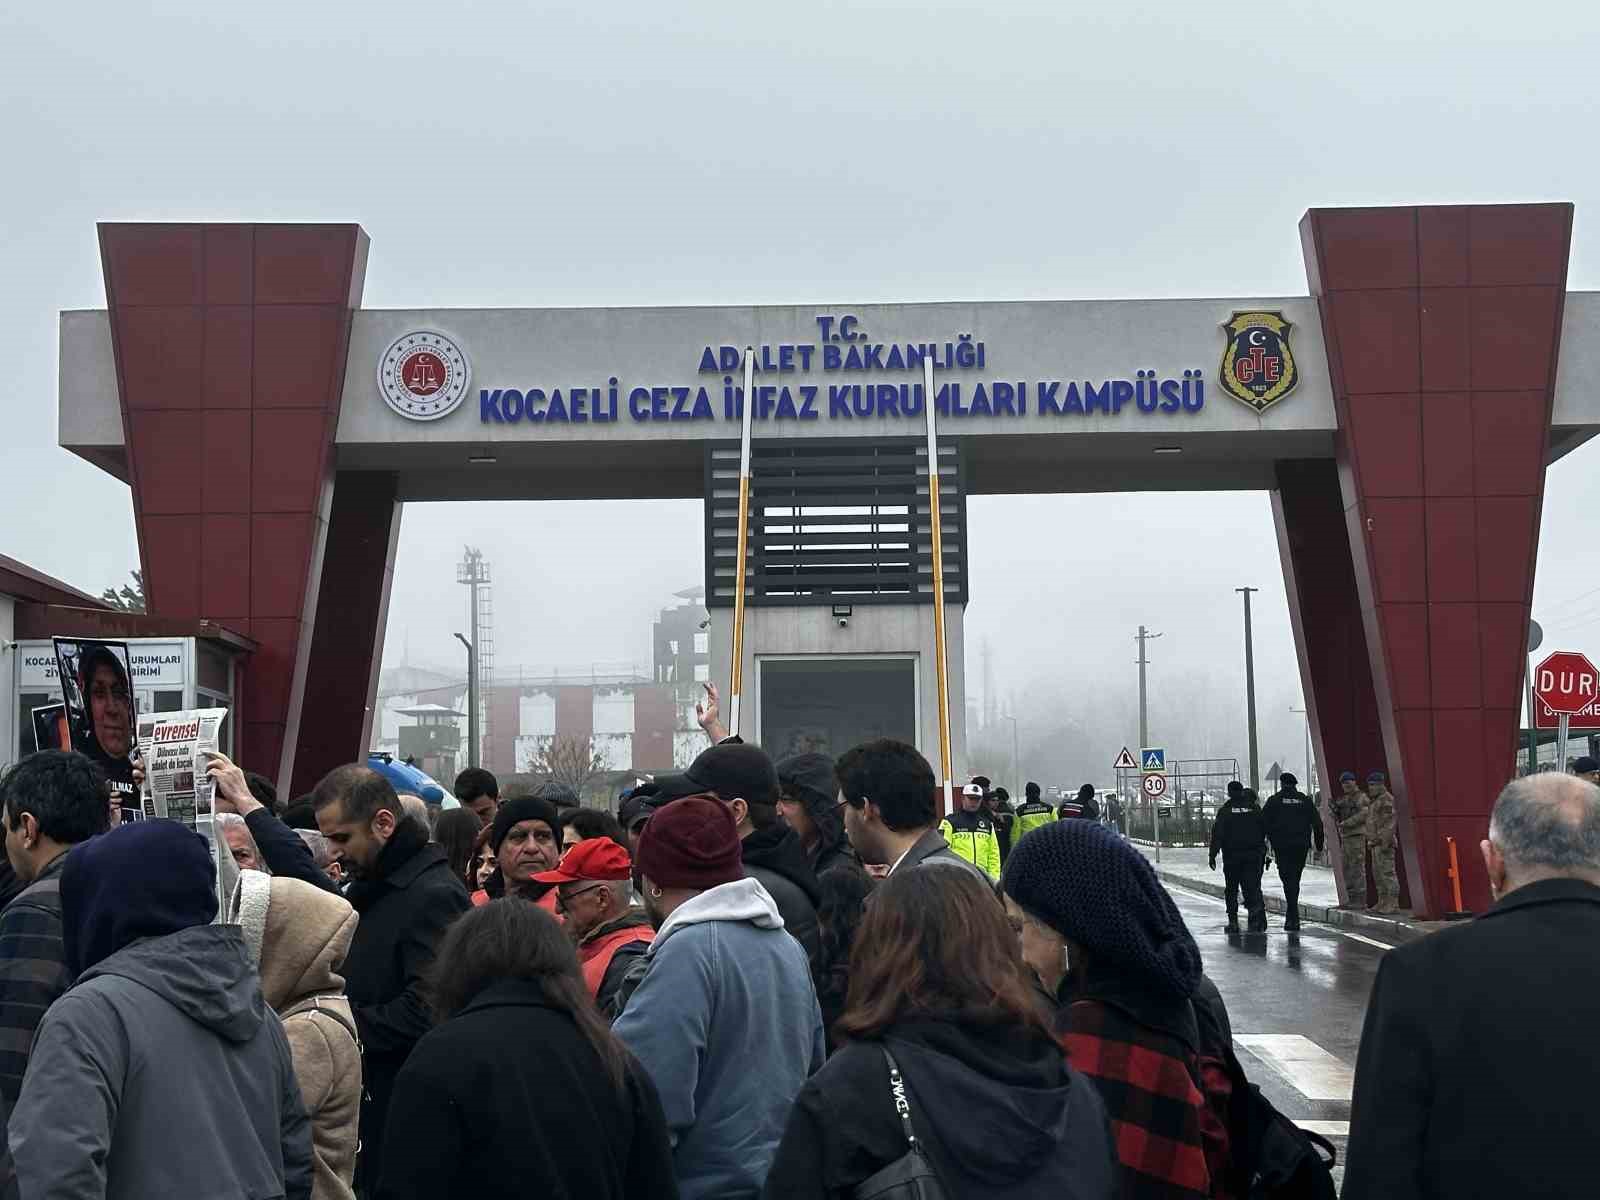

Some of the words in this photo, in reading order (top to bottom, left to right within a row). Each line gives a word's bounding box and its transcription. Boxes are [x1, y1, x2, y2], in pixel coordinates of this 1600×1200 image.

[816, 315, 867, 342] T.C.
[823, 333, 985, 370] BAKANLIĞI
[480, 376, 618, 422] KOCAELİ
[629, 386, 714, 421] CEZA
[1038, 369, 1204, 415] KAMPÜSÜ
[25, 657, 57, 666] KOCAE
[131, 655, 180, 664] URUMLARI
[1541, 670, 1592, 696] DUR
[154, 716, 200, 742] evrensel
[1147, 779, 1162, 791] 30
